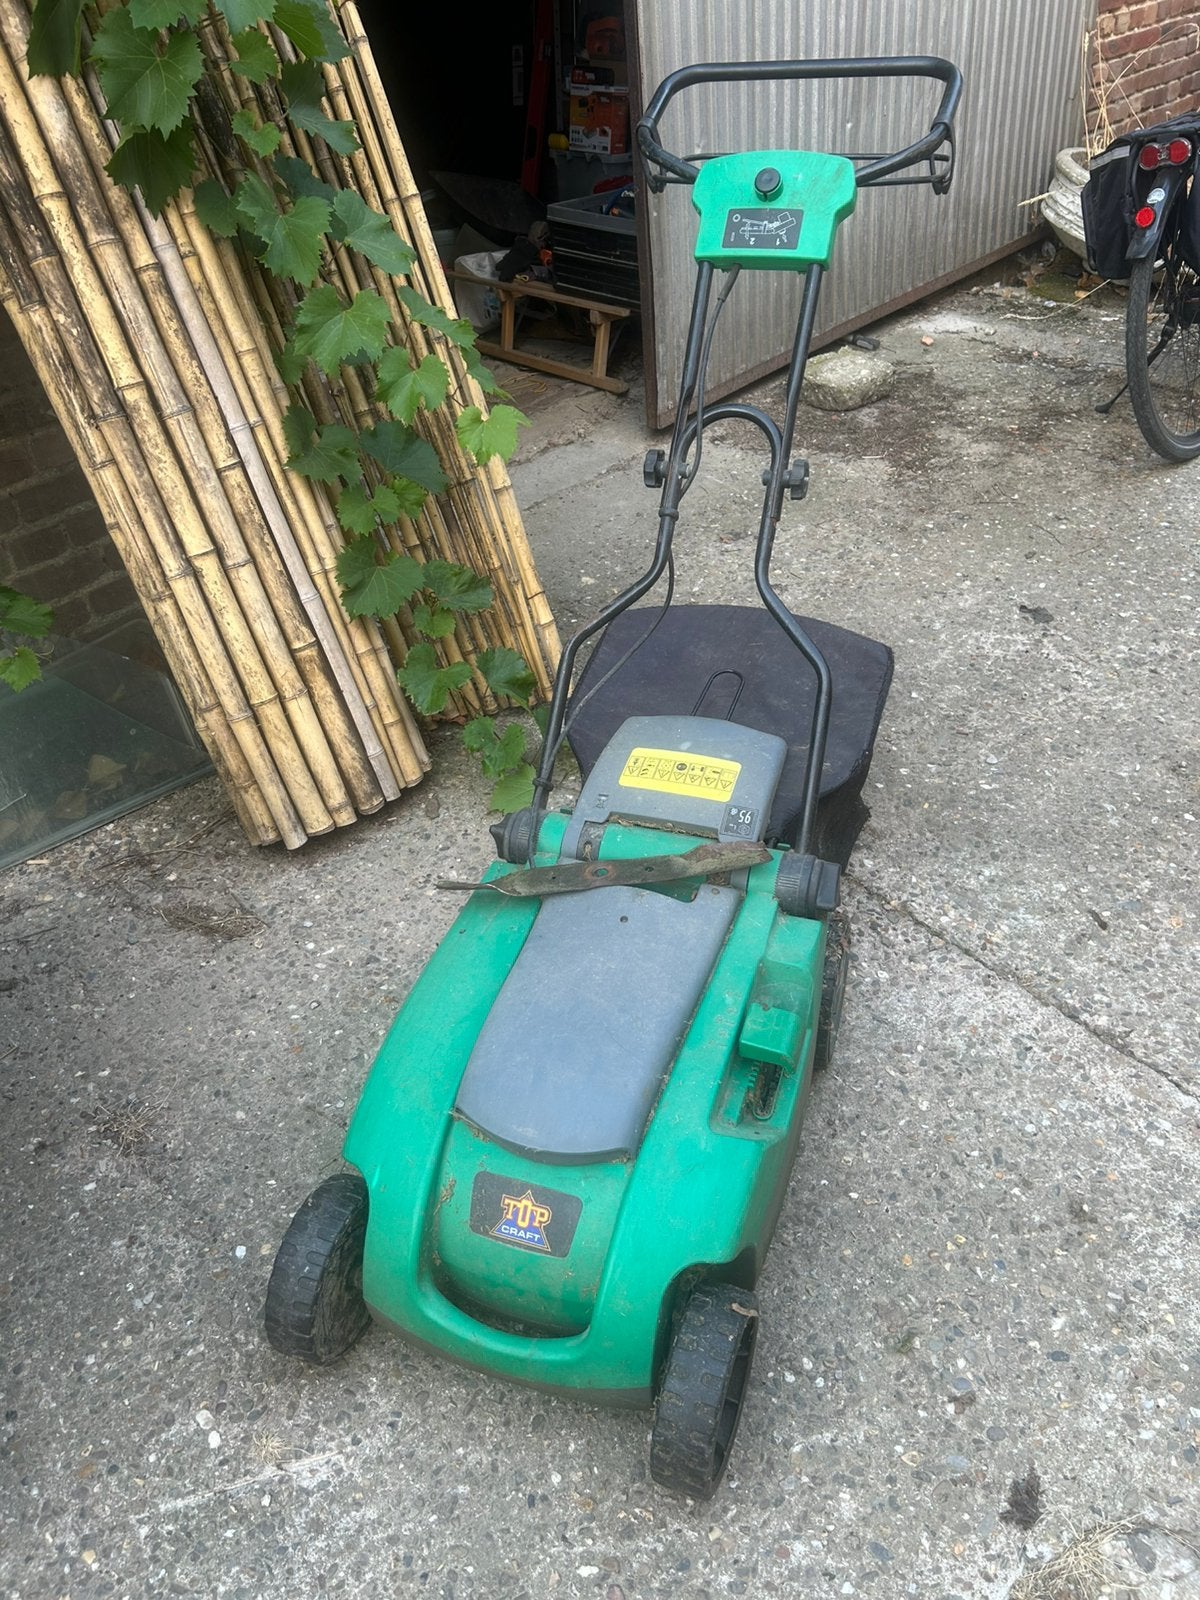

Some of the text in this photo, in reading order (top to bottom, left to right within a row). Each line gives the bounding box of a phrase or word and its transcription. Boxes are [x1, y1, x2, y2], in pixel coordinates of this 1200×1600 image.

[738, 810, 752, 824] 95
[503, 1198, 550, 1228] TOP
[501, 1225, 541, 1242] CRAFT
